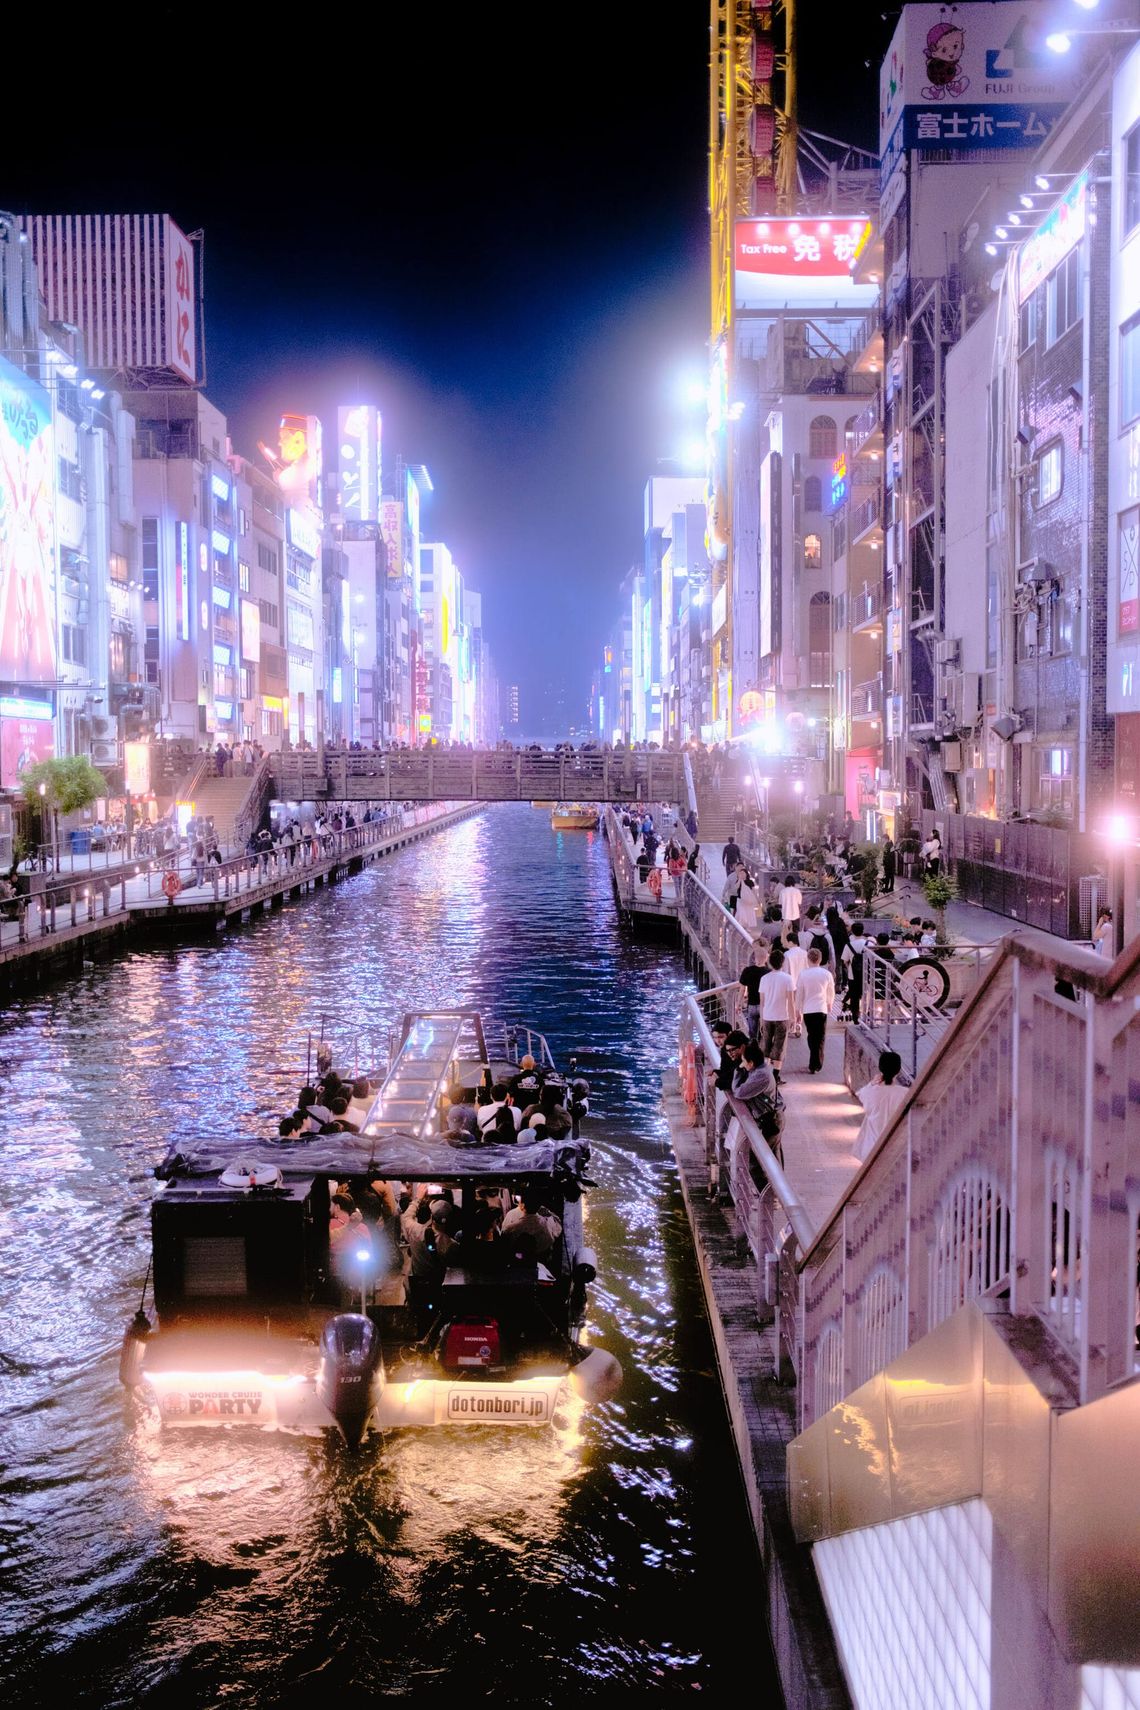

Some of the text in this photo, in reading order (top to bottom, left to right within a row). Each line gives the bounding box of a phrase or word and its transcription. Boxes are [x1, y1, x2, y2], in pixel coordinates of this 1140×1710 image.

[985, 84, 1013, 94] FUJI
[916, 112, 1057, 139] 富士ホーム
[741, 244, 760, 254] Tax
[189, 1391, 229, 1399] WONDER
[189, 1399, 262, 1414] PARTY
[452, 1396, 543, 1415] dotonbori.jp
